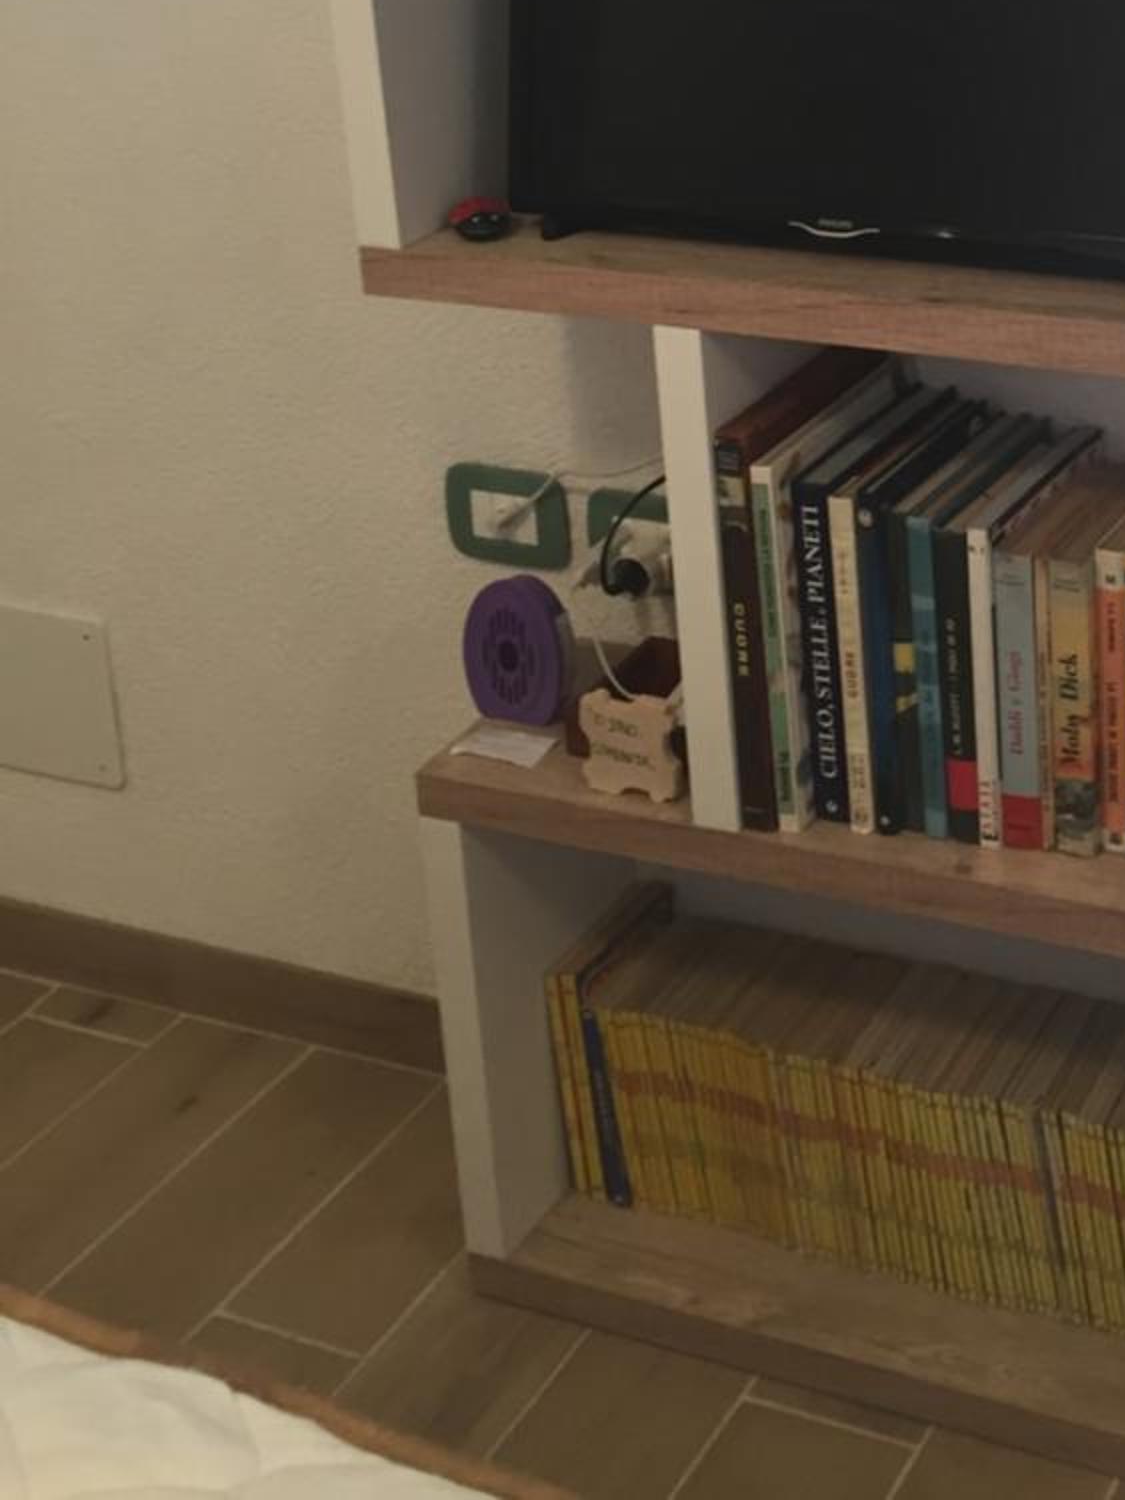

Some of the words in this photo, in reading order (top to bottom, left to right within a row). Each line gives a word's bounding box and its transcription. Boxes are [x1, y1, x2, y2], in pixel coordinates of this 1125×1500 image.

[802, 503, 825, 602] PIANETI
[810, 615, 831, 699] STELLE
[1059, 654, 1080, 704] Dick
[1060, 714, 1086, 771] Moby
